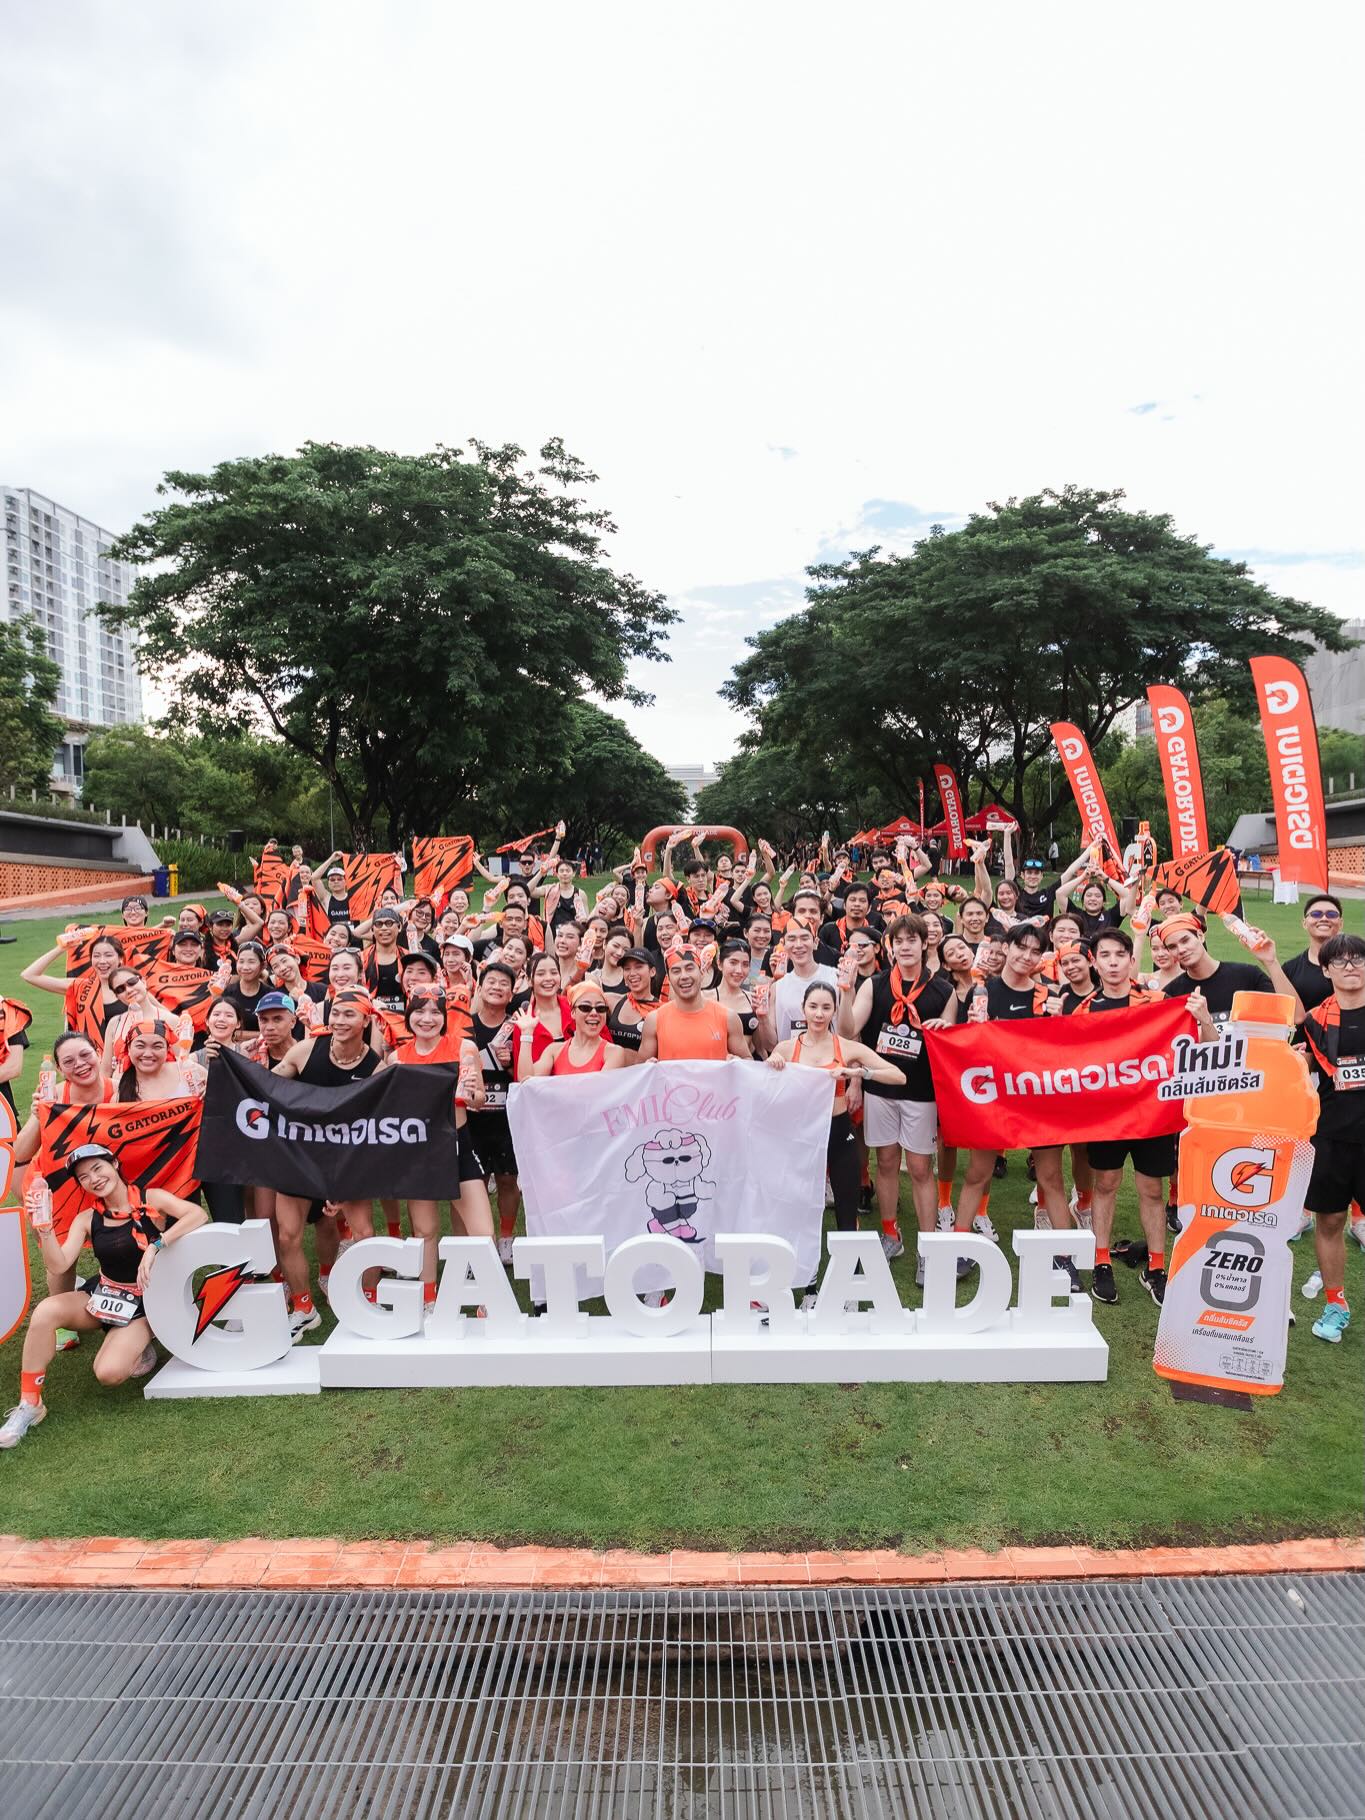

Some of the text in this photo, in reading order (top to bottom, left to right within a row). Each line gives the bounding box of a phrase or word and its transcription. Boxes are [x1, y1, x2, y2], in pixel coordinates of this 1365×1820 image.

[644, 852, 652, 862] G
[889, 1037, 911, 1050] 028
[1176, 1035, 1244, 1074] ใหม่!
[960, 1054, 1169, 1104] G เกเตอเรด
[1161, 1072, 1260, 1098] กลิ่นส้มซิตรัส
[1342, 1068, 1365, 1079] 035
[108, 1101, 193, 1139] G GATORADE
[235, 1097, 428, 1145] G เกเตอเรด
[1211, 1146, 1276, 1207] G
[1200, 1203, 1278, 1227] เกเตอเรด
[1204, 1250, 1264, 1274] ZERO
[100, 1299, 124, 1313] 010
[143, 1218, 1096, 1372] G GATORADE
